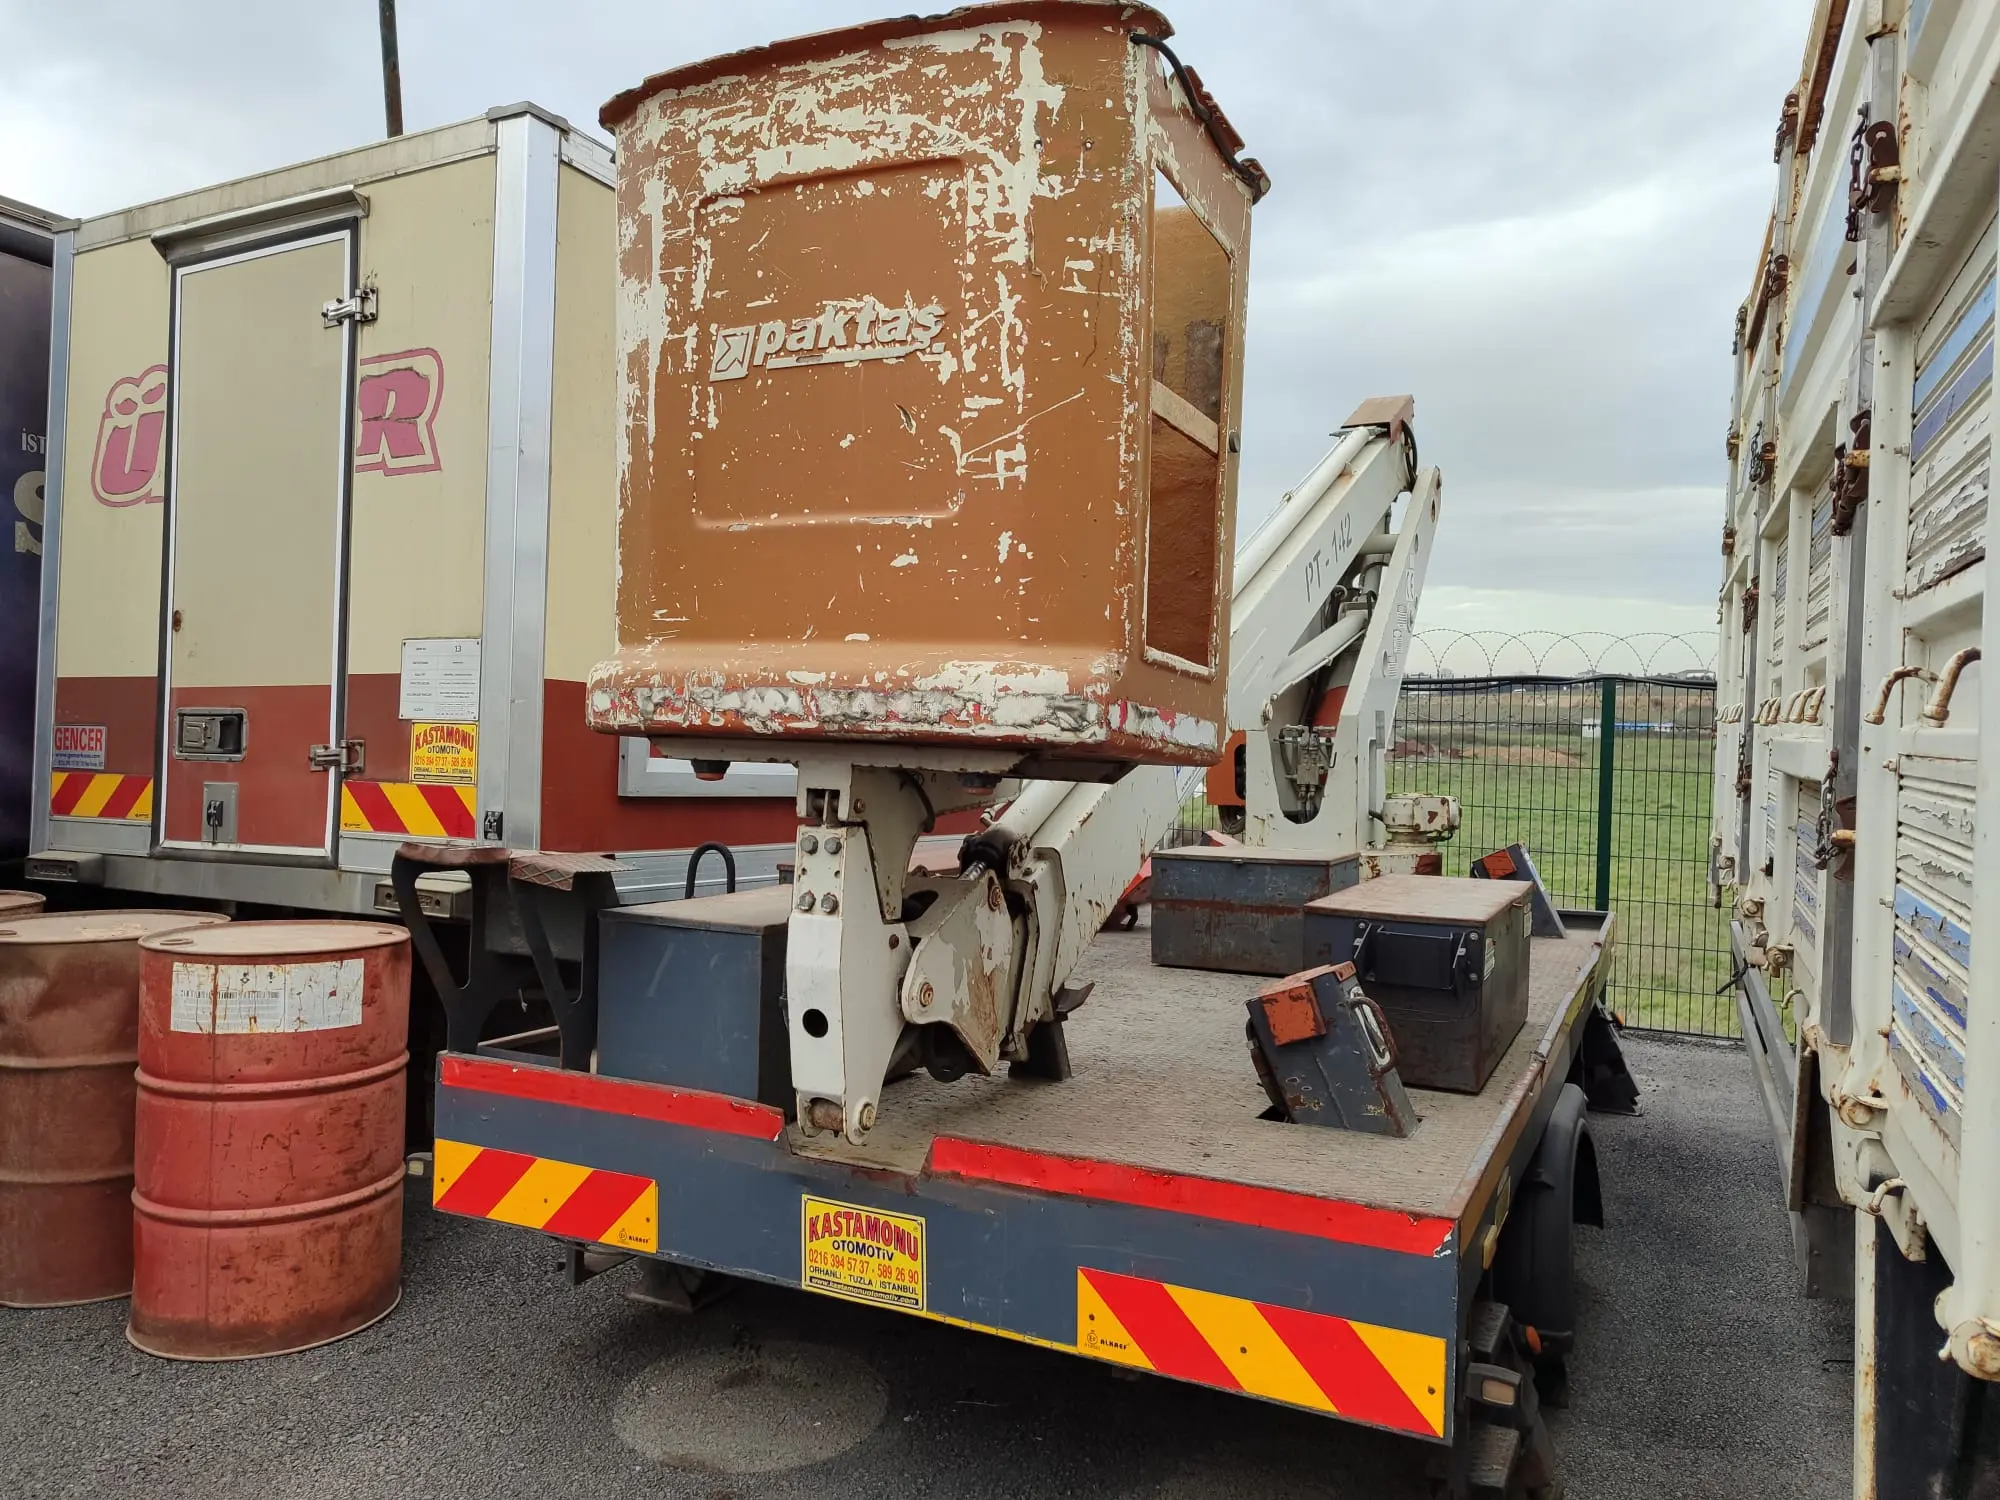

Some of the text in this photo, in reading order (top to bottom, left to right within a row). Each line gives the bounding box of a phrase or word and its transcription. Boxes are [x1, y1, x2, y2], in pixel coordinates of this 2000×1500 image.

[54, 727, 103, 752] GENCER
[415, 725, 474, 753] KASTAMONU
[808, 1210, 919, 1262] KASTAMONU
[808, 1248, 829, 1266] 0216
[830, 1254, 845, 1269] 394
[848, 1257, 858, 1273] 57
[860, 1260, 870, 1275] 37
[877, 1263, 892, 1280] 589
[895, 1266, 906, 1282] 26
[908, 1269, 919, 1285] 90
[809, 1265, 842, 1279] ORHANLI
[848, 1274, 874, 1288] TUZLA
